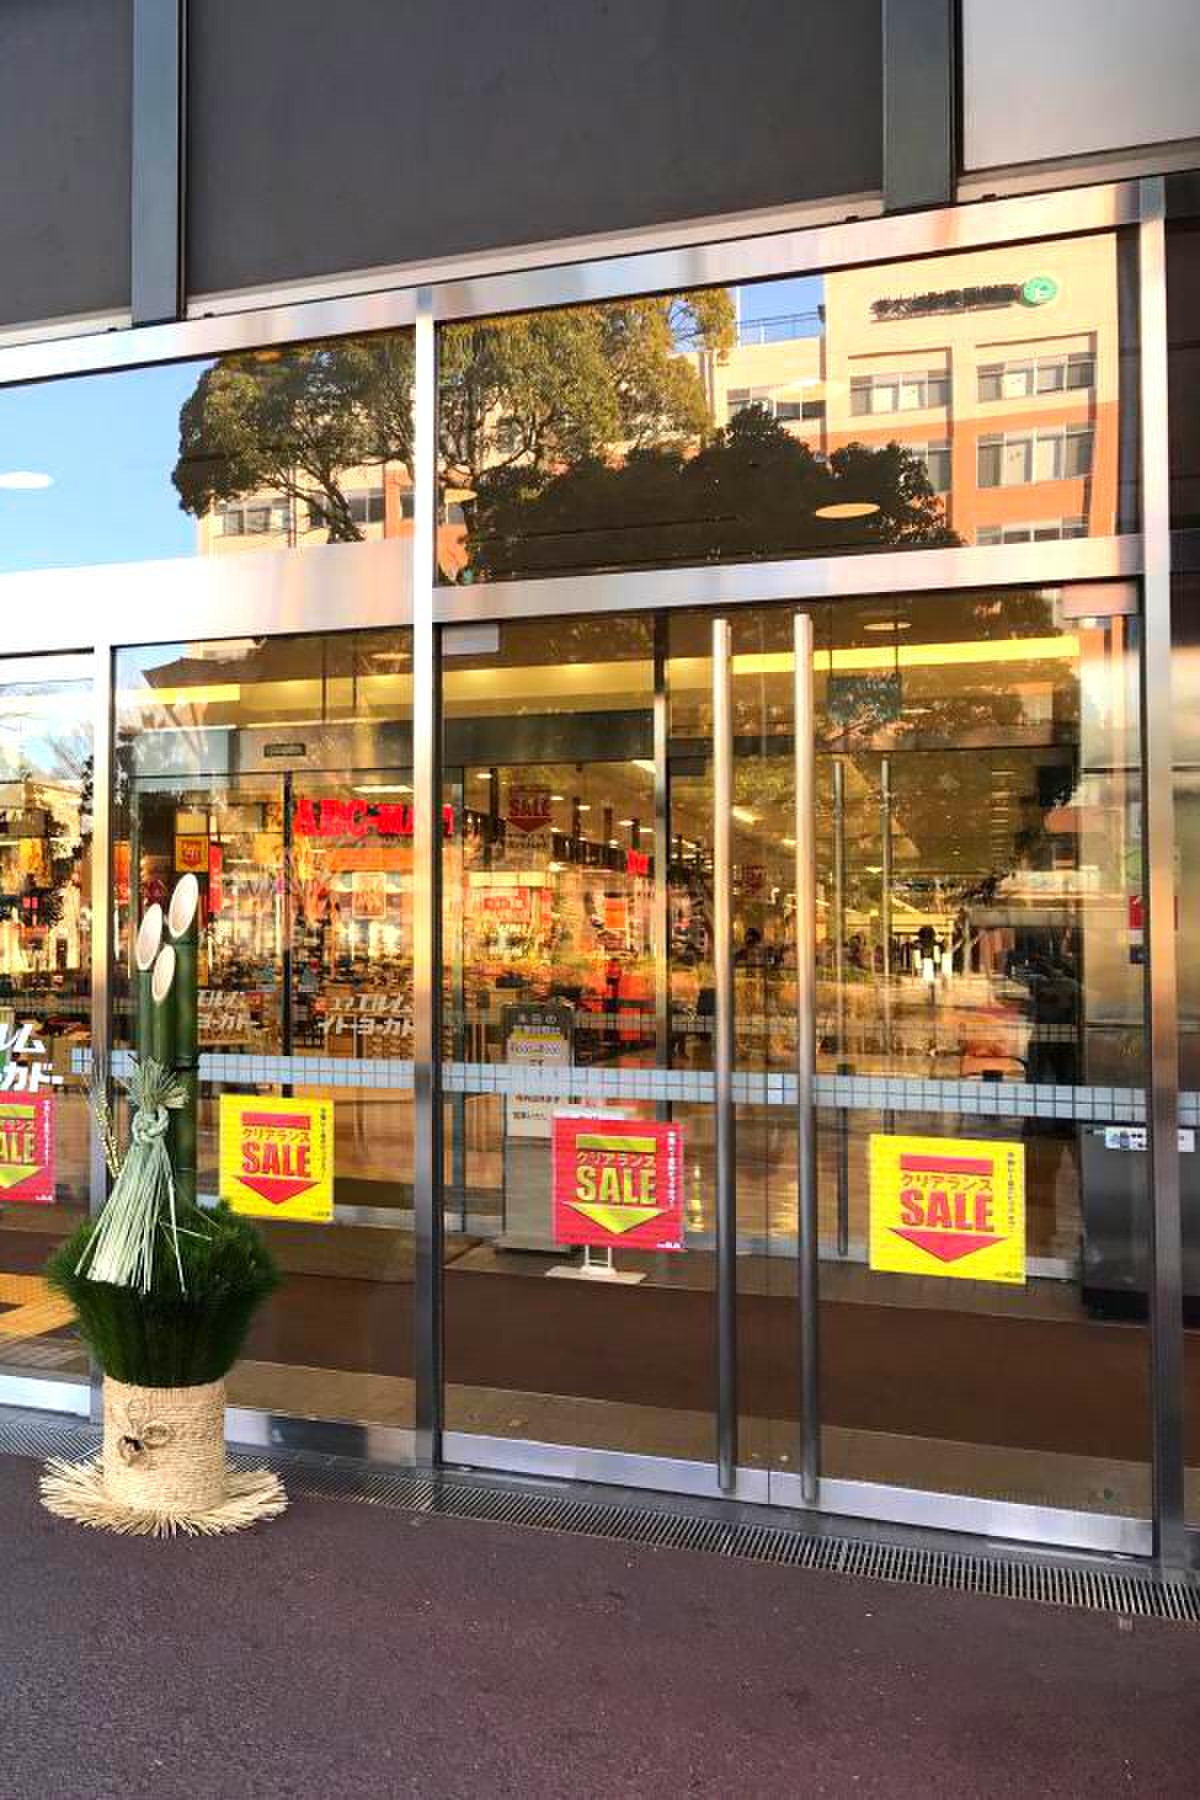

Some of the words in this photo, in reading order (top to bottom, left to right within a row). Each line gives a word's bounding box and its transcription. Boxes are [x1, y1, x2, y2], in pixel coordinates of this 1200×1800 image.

[242, 1128, 311, 1142] クリアランス
[241, 1141, 312, 1177] SALE
[576, 1165, 657, 1205] SALE
[901, 1173, 993, 1191] クリアランス
[900, 1189, 994, 1233] SALE
